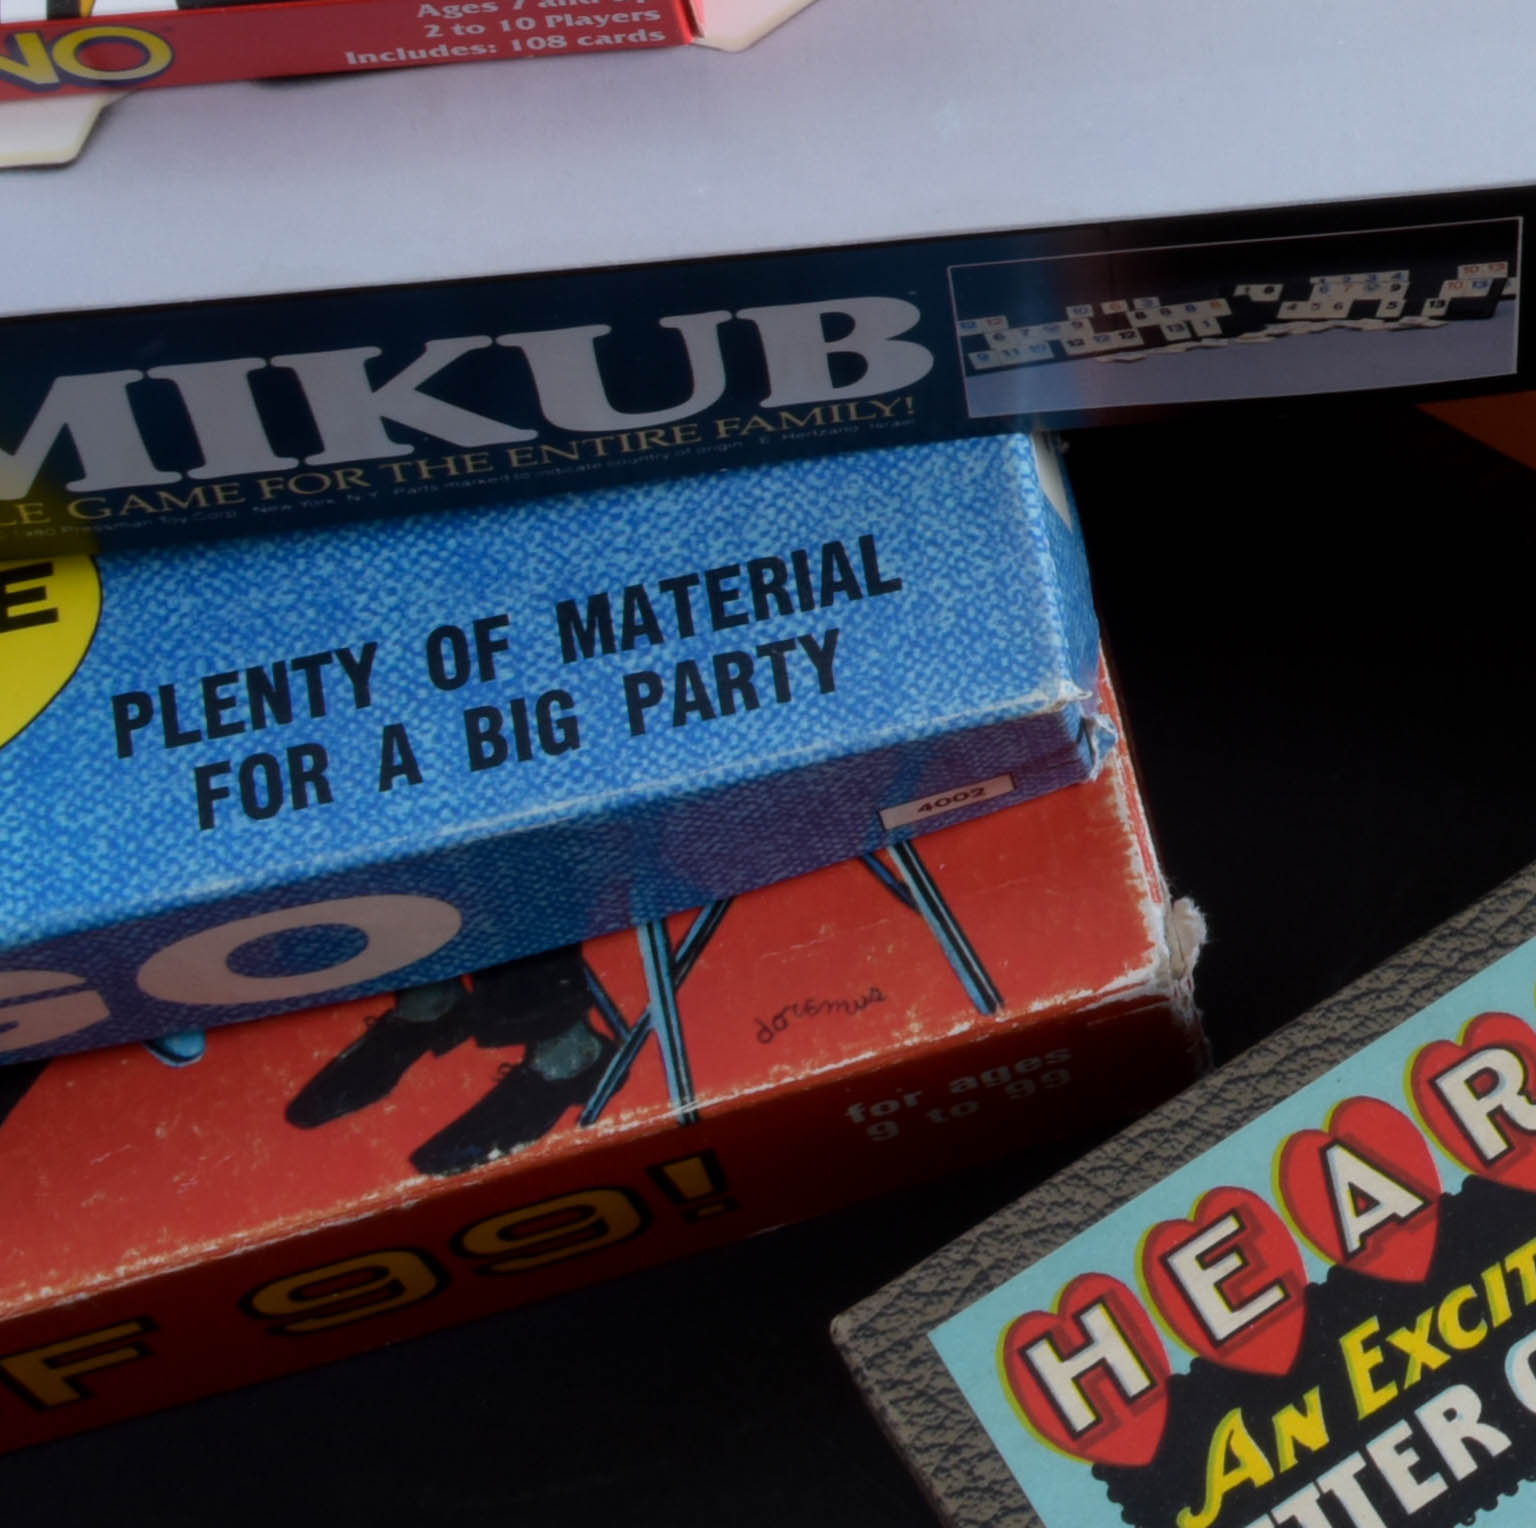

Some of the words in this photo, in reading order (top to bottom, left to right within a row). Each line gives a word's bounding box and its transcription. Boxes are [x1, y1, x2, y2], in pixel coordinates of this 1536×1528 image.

[345, 42, 499, 66] Includes:
[509, 35, 566, 55] 108
[576, 26, 665, 49] cards
[423, 22, 443, 38] 2
[458, 17, 489, 37] to
[499, 14, 537, 33] 10
[545, 5, 661, 33] Players
[66, 480, 246, 521] GAME
[257, 466, 371, 502] FOR
[377, 451, 493, 486] THE
[507, 425, 702, 470] ENTIRE
[714, 396, 917, 439] FAMILY!
[112, 644, 380, 759] PLENTY
[426, 616, 512, 691] OF
[556, 534, 903, 663] MATERIAL
[194, 739, 332, 826] FOR
[377, 724, 422, 793] A
[464, 690, 580, 773] BIG
[625, 628, 841, 737] PARTY
[917, 786, 987, 814] 4002
[845, 1089, 924, 1126] for
[948, 1048, 1072, 1094] ages
[243, 1153, 737, 1336] 99!
